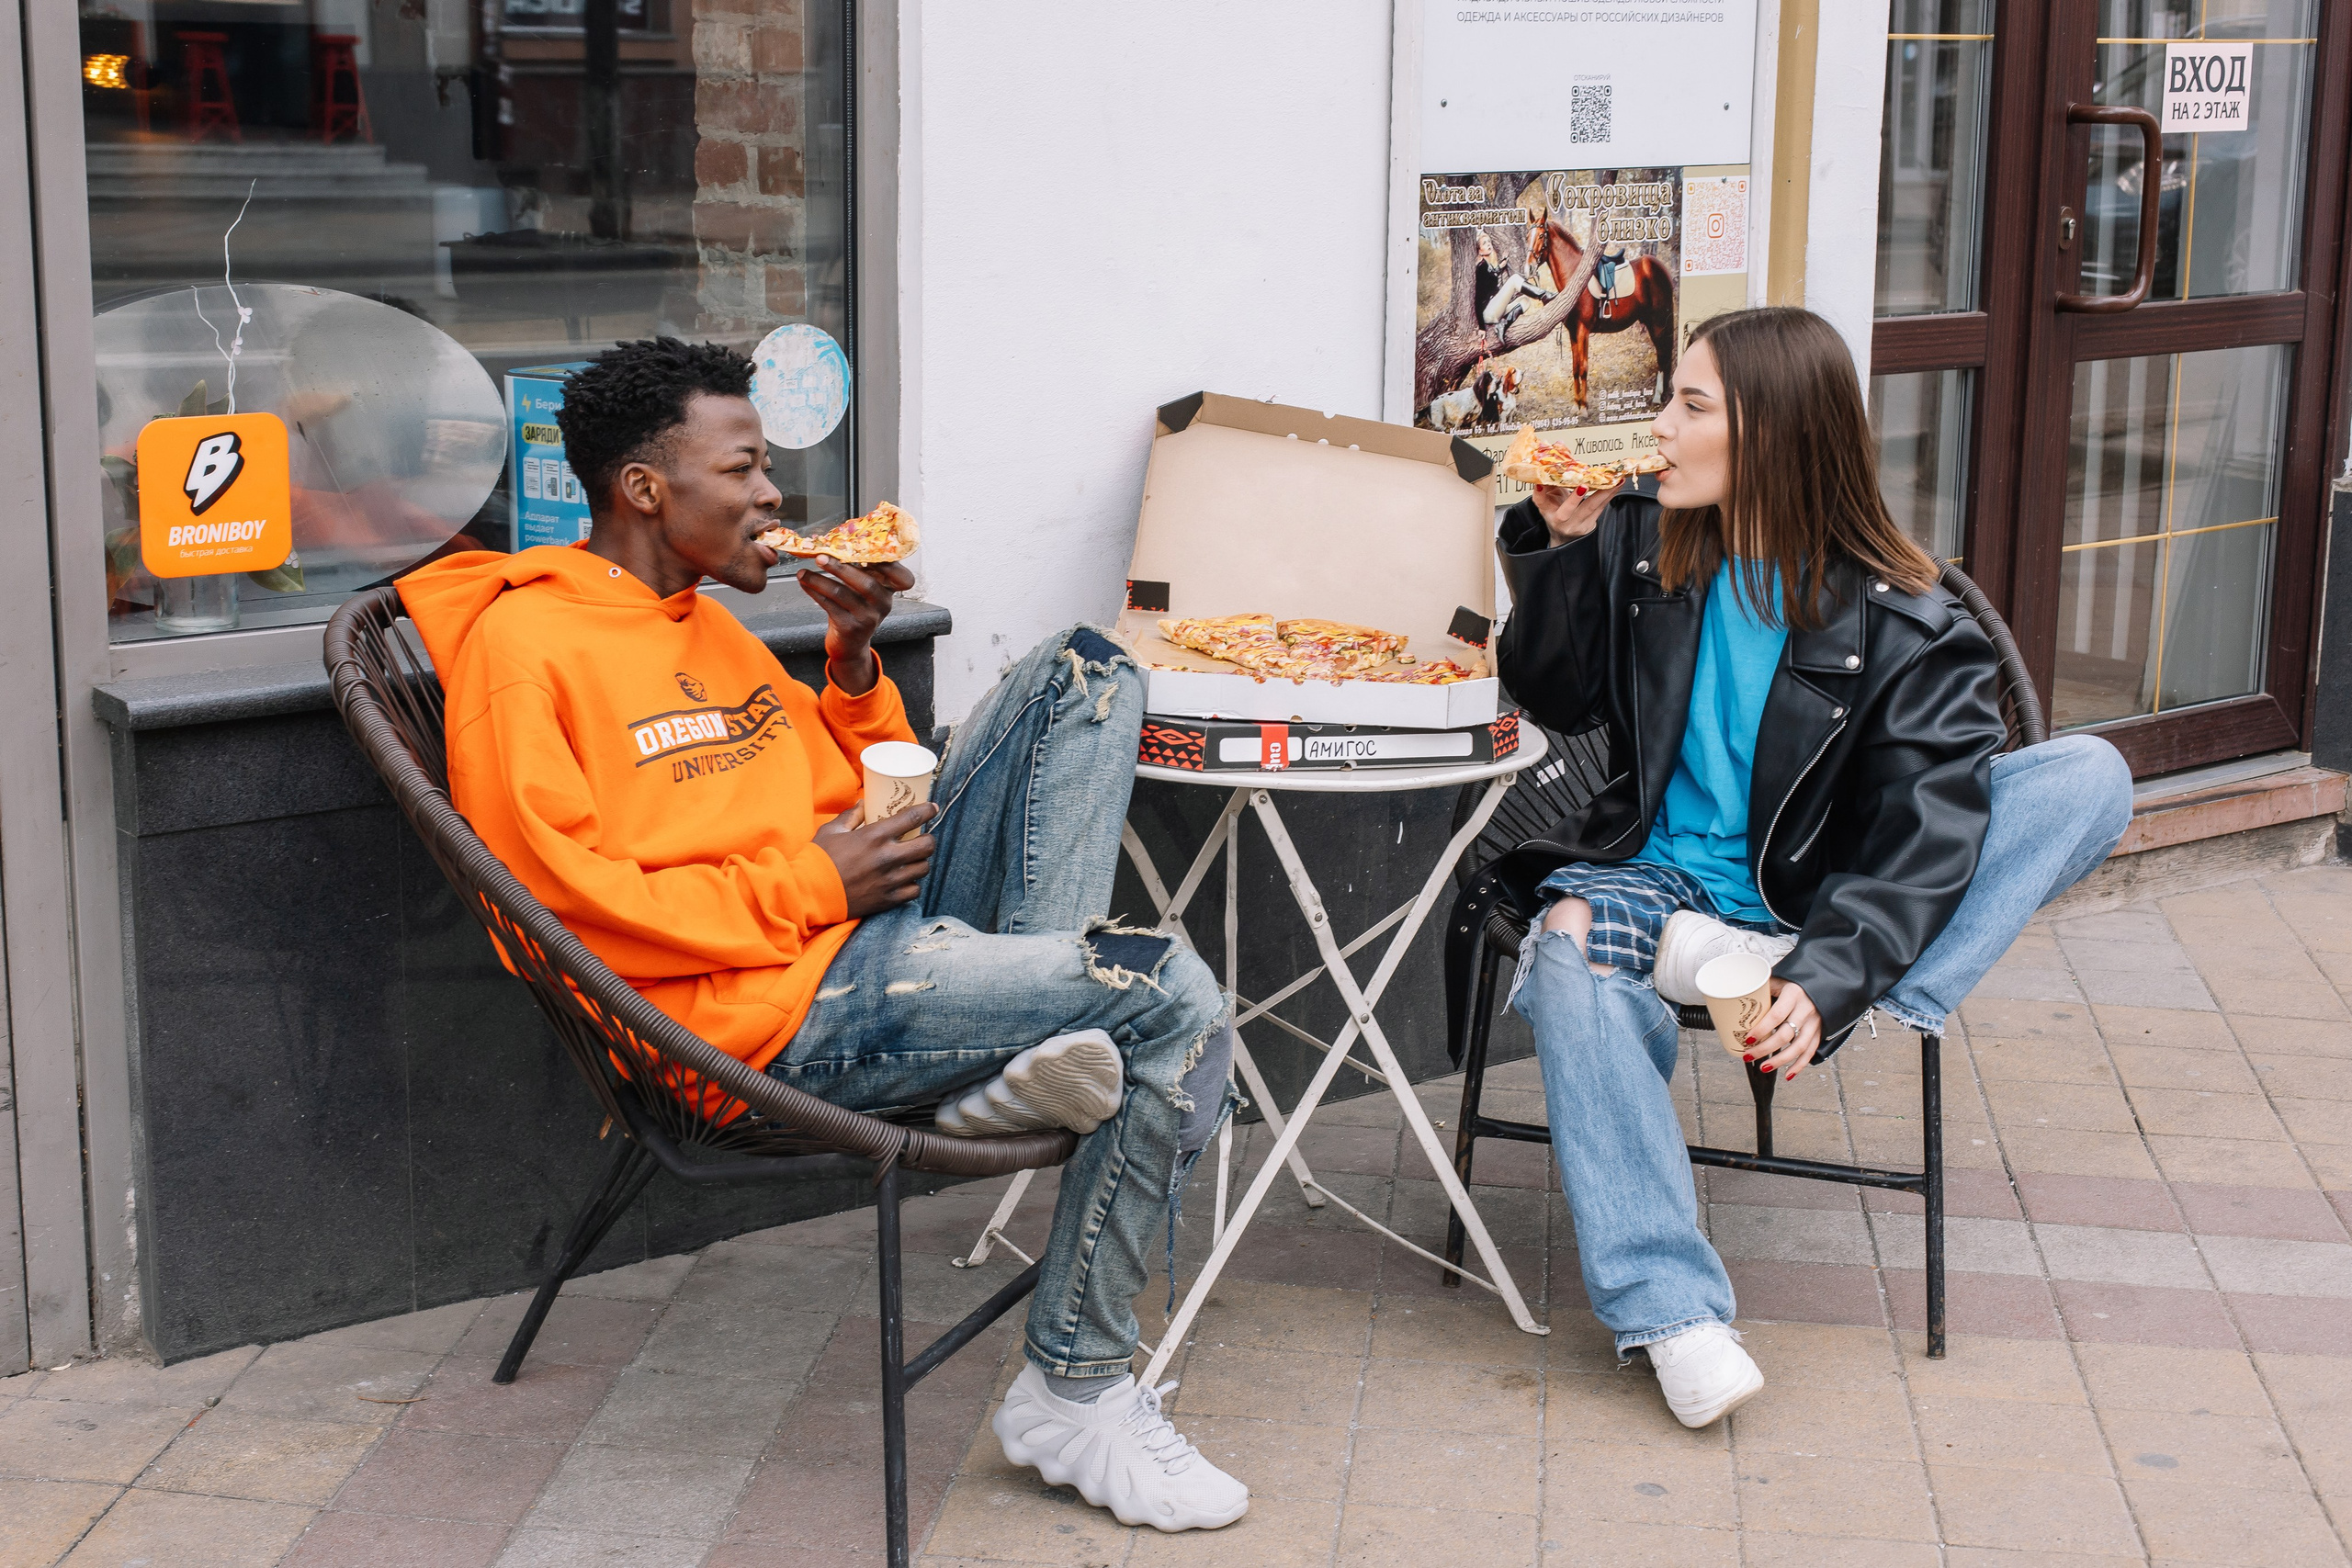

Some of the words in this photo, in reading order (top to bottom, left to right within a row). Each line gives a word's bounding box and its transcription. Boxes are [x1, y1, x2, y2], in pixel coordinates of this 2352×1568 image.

[1456, 11, 1501, 23] ОДЕЖДА
[1504, 11, 1511, 22] И
[1513, 11, 1578, 22] АКСЕССУАРЫ
[1580, 11, 1593, 22] ОТ
[1595, 10, 1659, 23] РОССИЙСКИХ
[1660, 10, 1724, 23] ДИЗАЙНЕРОВ
[2168, 55, 2246, 96] ВХОД
[2171, 102, 2189, 119] НА
[2192, 102, 2200, 118] 2
[2204, 101, 2240, 119] ЭТАЖ
[1422, 180, 1466, 203] Охота
[1468, 186, 1485, 202] за
[1546, 173, 1672, 216] Сокровища
[1423, 209, 1526, 230] антиквариатом
[1597, 210, 1671, 242] близко
[535, 398, 561, 412] Бери
[525, 425, 560, 445] ЗАРЯДИ
[1574, 437, 1624, 455] Живопись
[1632, 433, 1659, 449] Аксес
[524, 511, 560, 524] Аппарат
[168, 519, 266, 547] BRONIBOY
[524, 524, 555, 534] выдает
[525, 535, 571, 546] powerbank
[179, 548, 214, 558] быстрая
[215, 546, 254, 557] доставка
[635, 713, 728, 756] OREGON
[724, 689, 781, 736] STAT
[673, 716, 793, 783] UNIVERSITY
[1309, 739, 1377, 758] АМИГОС
